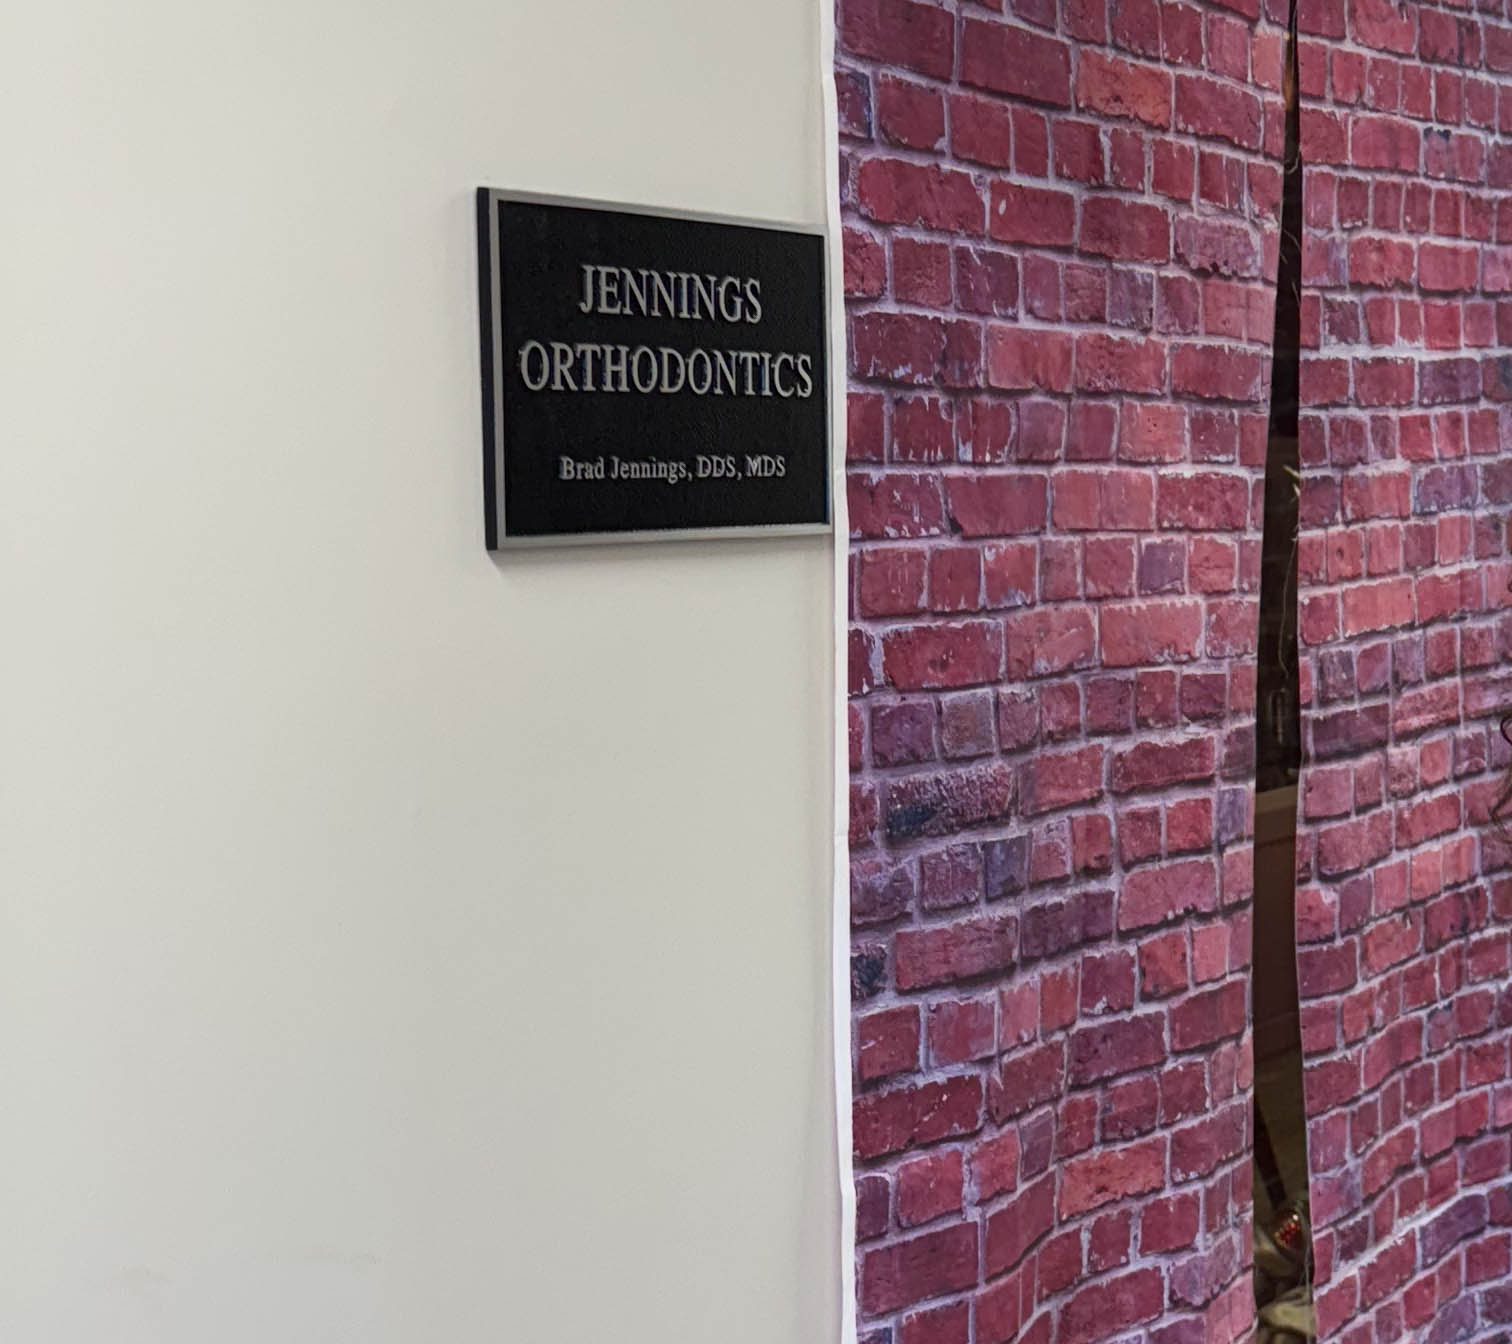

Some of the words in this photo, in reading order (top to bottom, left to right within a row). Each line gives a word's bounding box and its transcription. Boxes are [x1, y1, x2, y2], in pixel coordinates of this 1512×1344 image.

[578, 263, 763, 325] JENNINGS
[517, 339, 814, 399] ORTHODONTICS
[559, 456, 605, 481] Brad
[610, 455, 693, 485] Jennings,
[695, 454, 742, 481] DDS,
[744, 454, 786, 478] MDS
